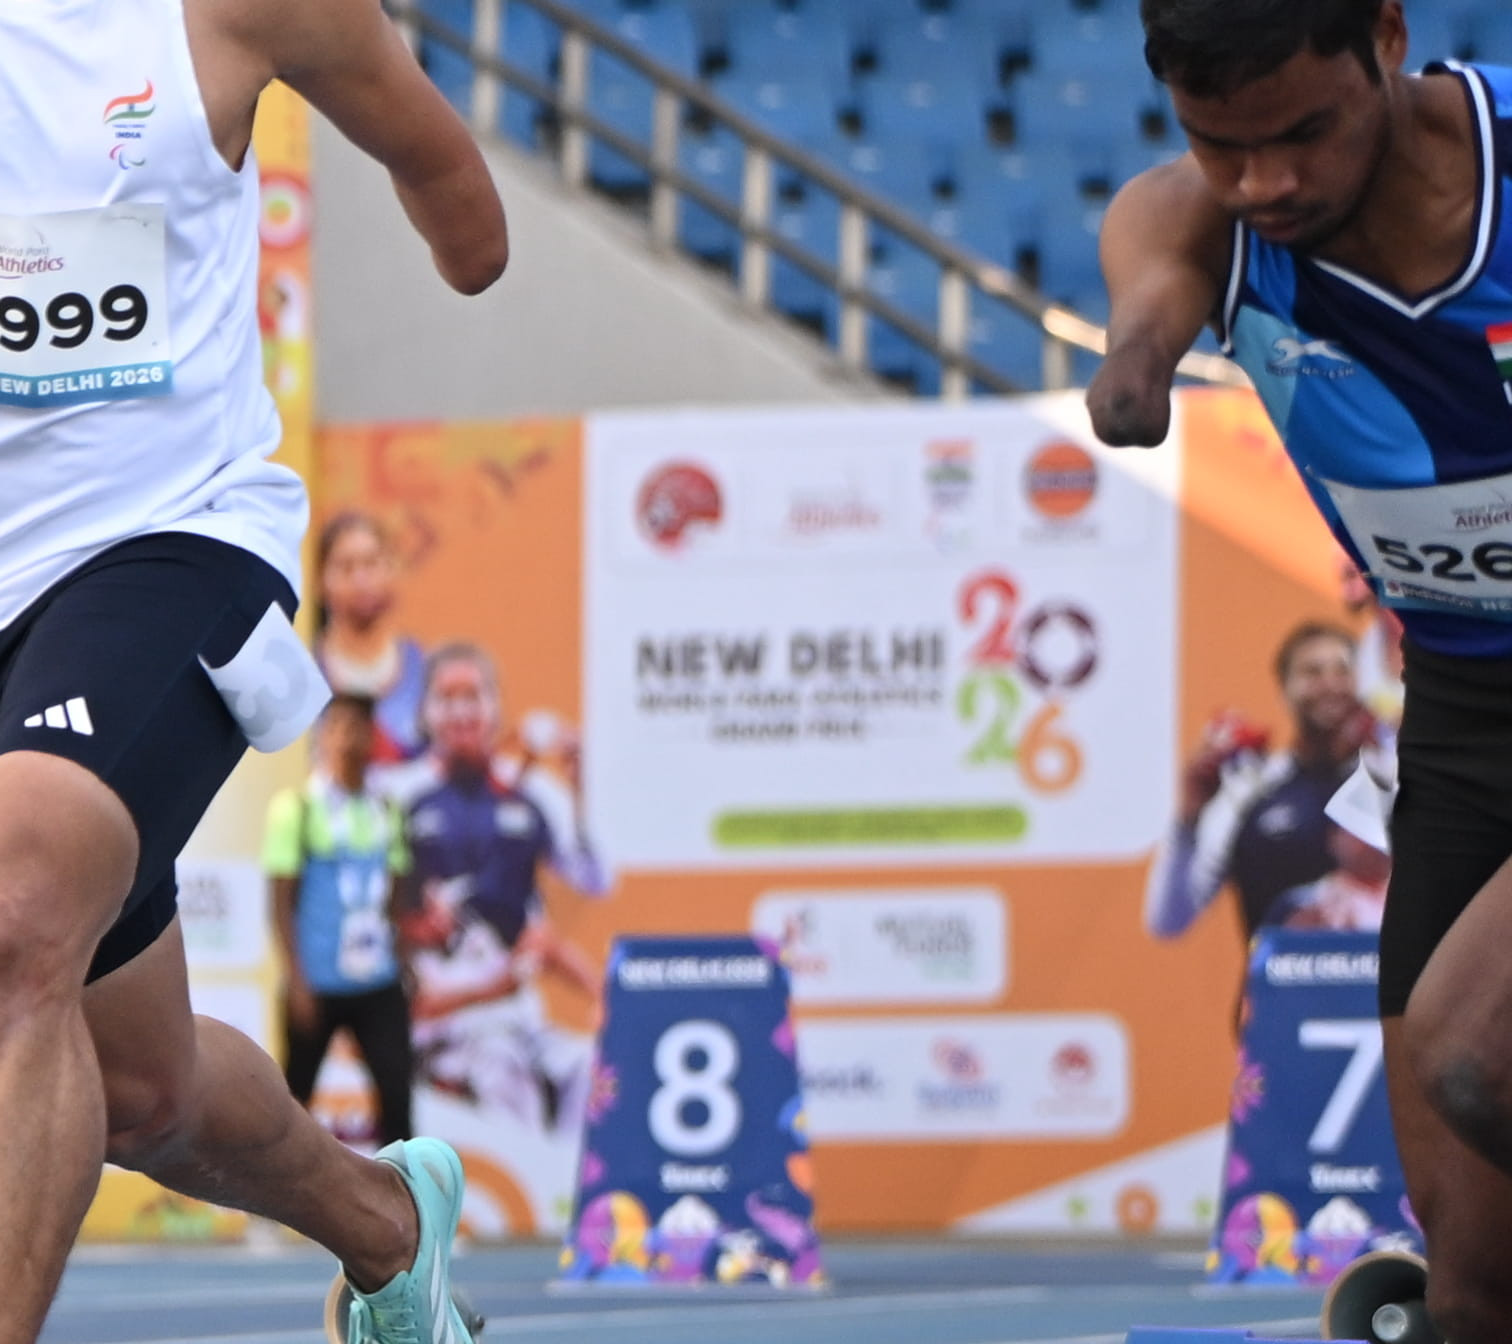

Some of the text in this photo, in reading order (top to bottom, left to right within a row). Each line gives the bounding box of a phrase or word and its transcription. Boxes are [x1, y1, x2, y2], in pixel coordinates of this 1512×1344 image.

[37, 373, 104, 396] DELHI
[110, 366, 164, 388] 2026
[634, 628, 947, 678] NEW DELHI
[647, 1017, 742, 1158] 8
[1297, 1017, 1385, 1155] 7
